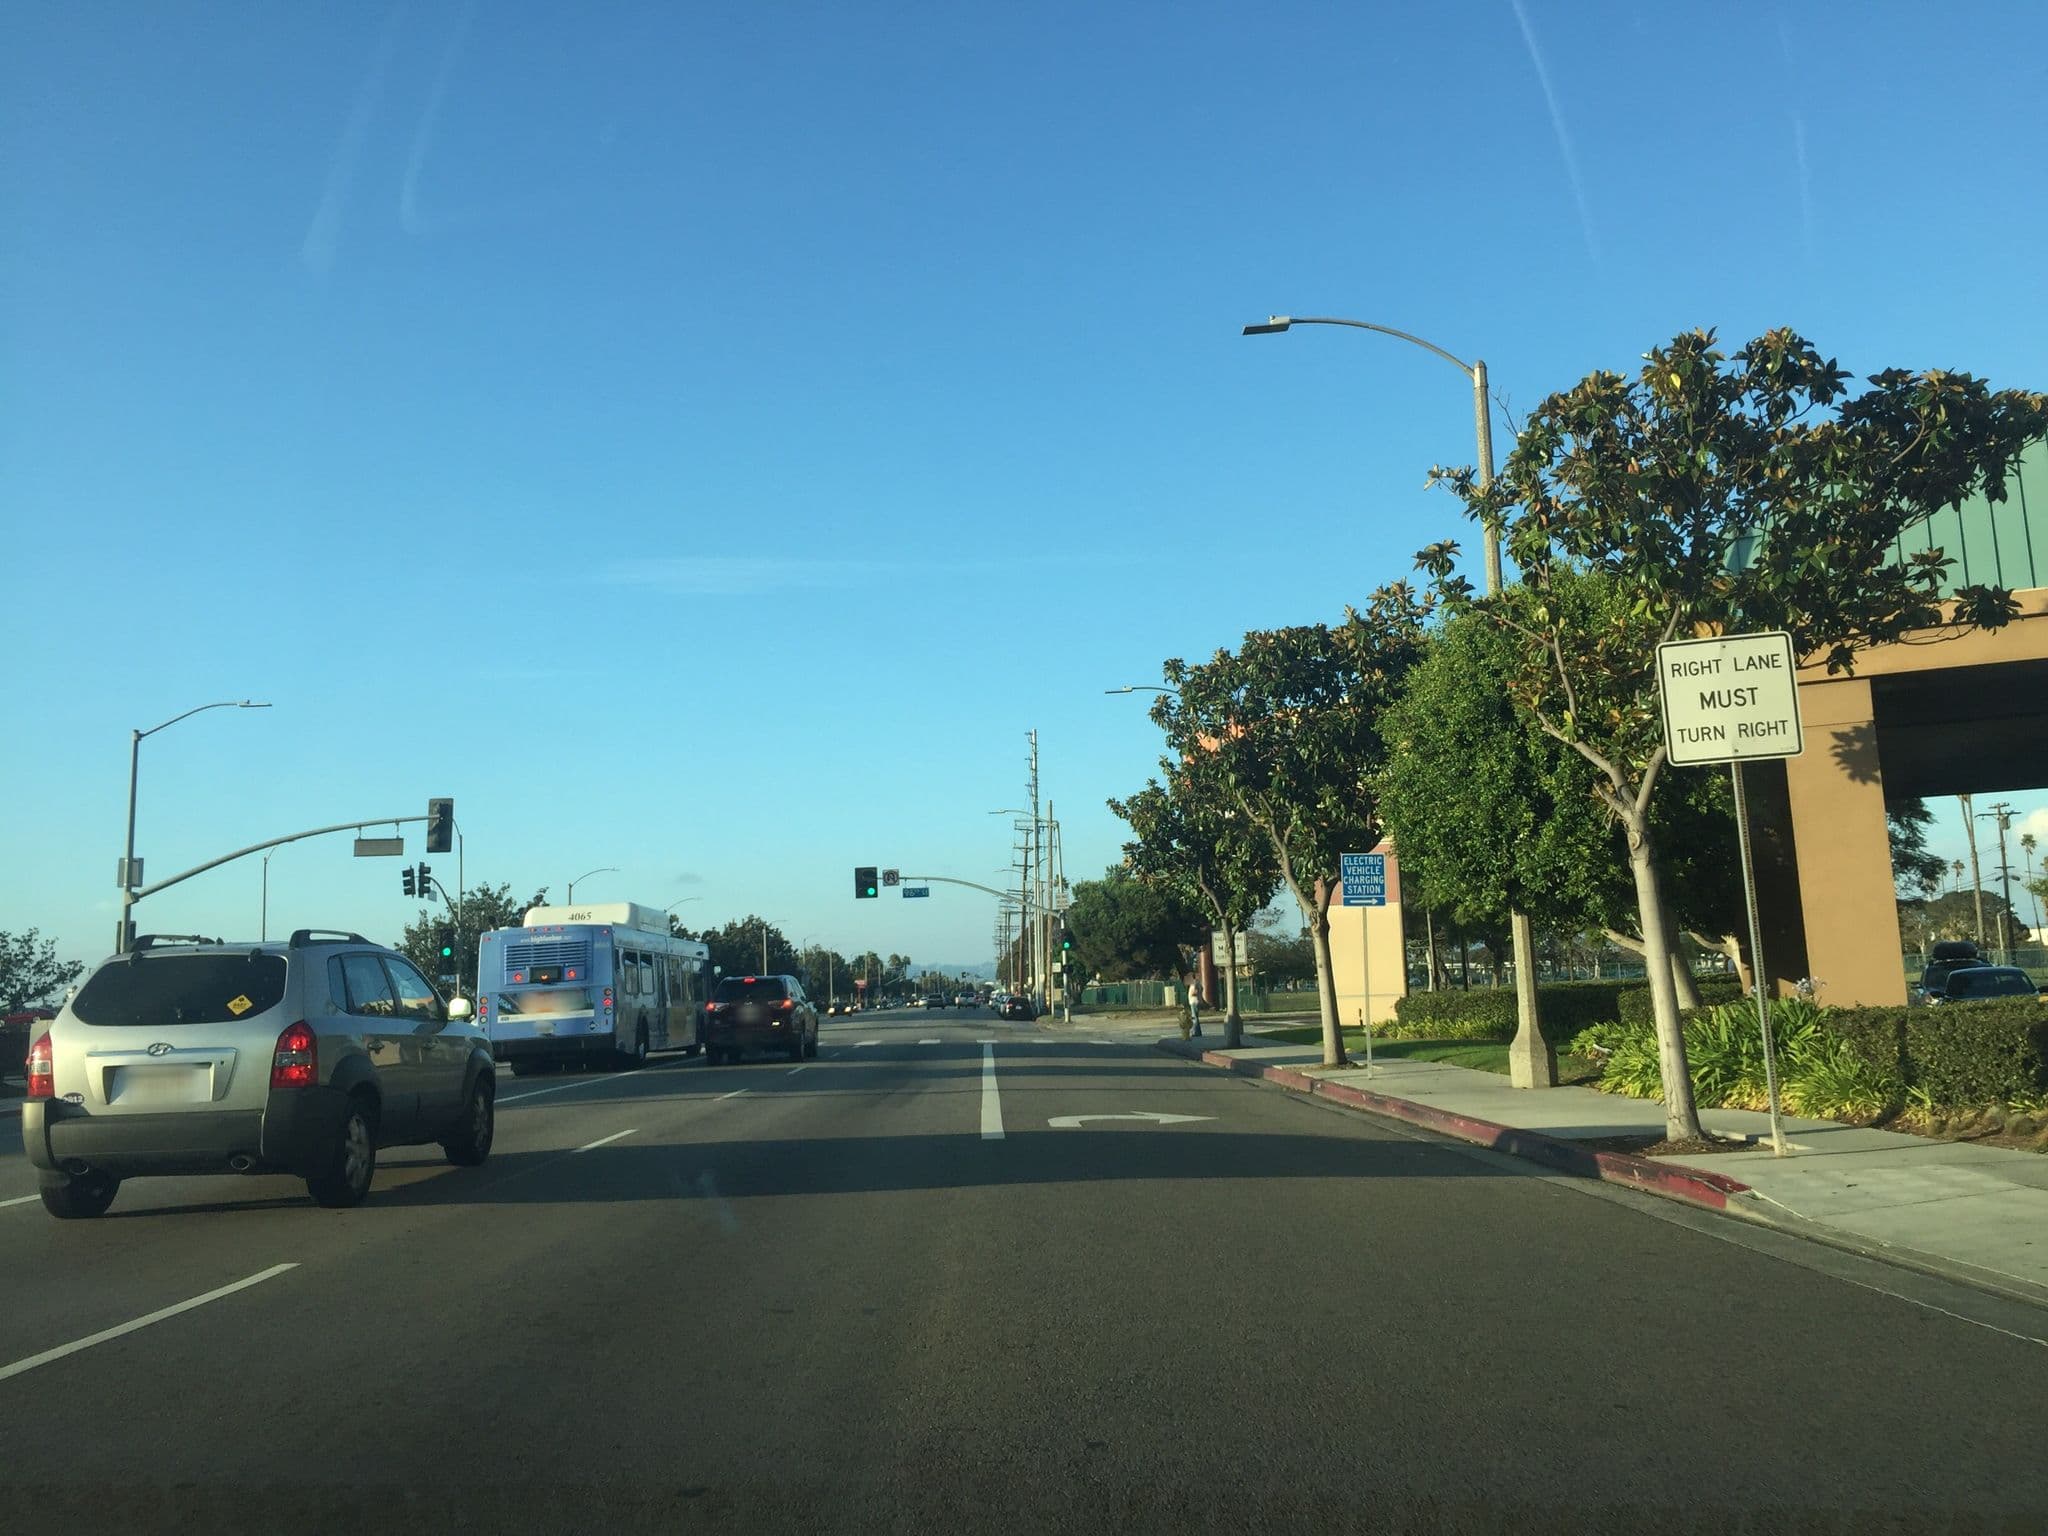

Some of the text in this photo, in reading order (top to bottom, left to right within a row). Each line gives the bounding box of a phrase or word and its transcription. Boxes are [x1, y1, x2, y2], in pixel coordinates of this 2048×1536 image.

[1671, 653, 1782, 678] RIGHT LANE
[1699, 687, 1758, 710] MUST
[1677, 720, 1789, 743] TURN RIGHT
[1343, 856, 1383, 866] ELECTRIC
[1346, 866, 1381, 875] VEHICLE
[1343, 875, 1384, 885] CHARGING
[1347, 885, 1381, 894] STATION
[568, 911, 592, 921] 4065
